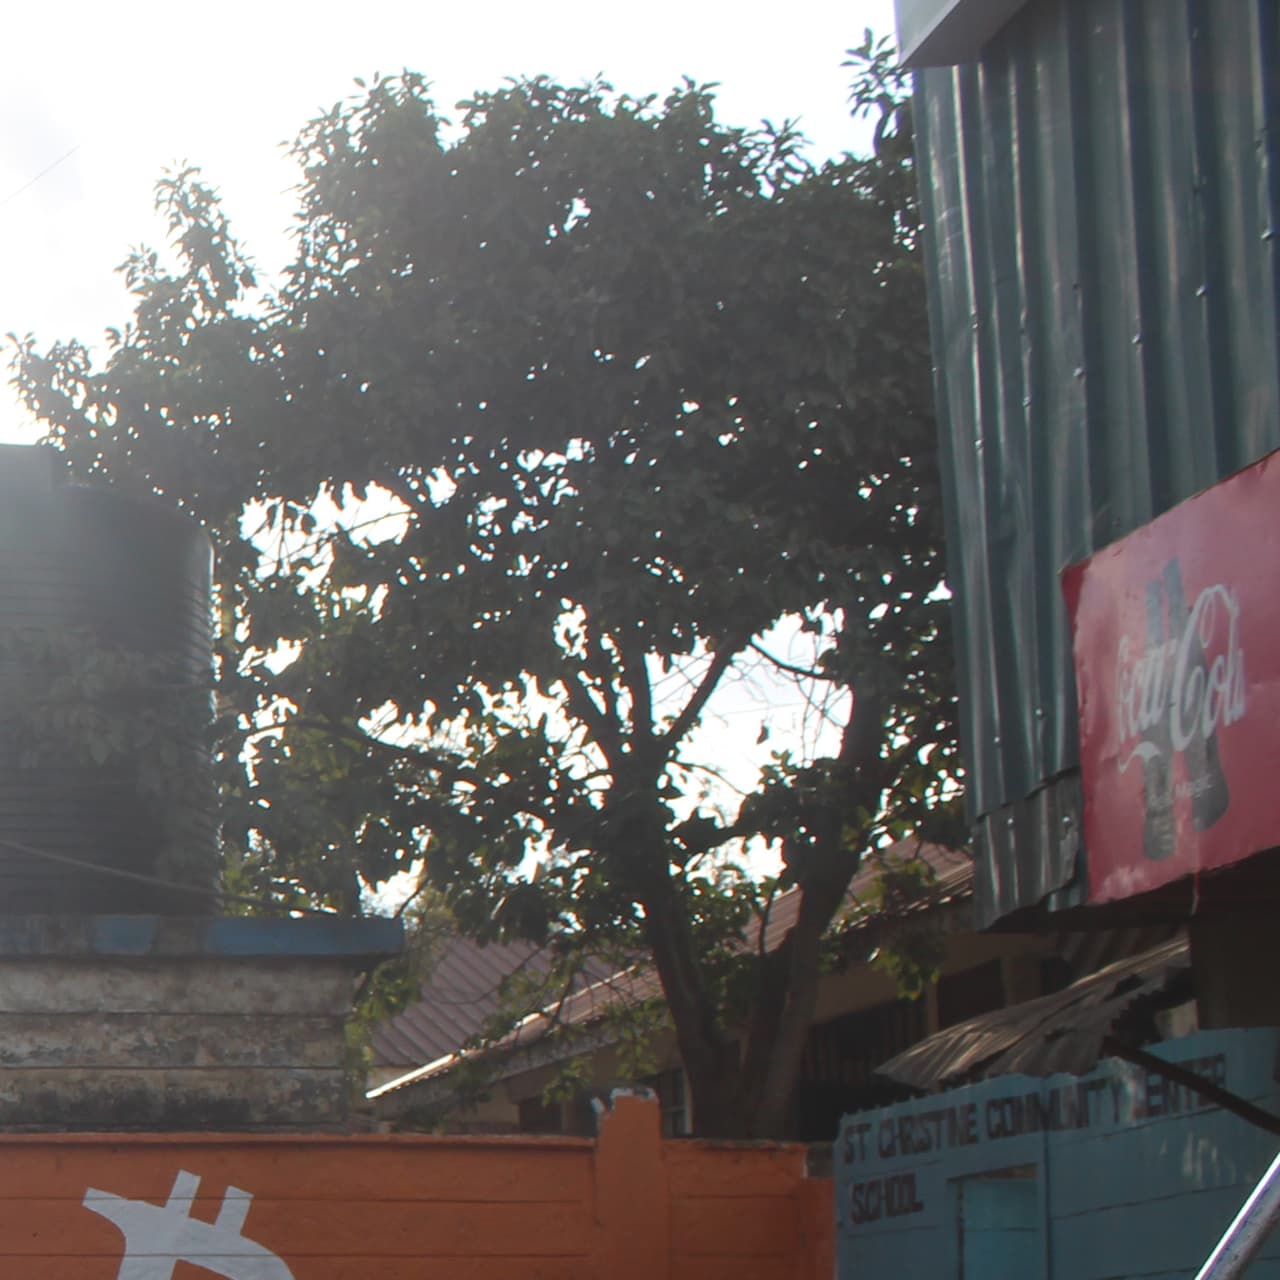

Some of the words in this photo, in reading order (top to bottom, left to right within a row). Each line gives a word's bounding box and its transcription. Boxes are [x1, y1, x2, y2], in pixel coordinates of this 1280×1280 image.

[843, 1123, 872, 1164] ST
[985, 1076, 1124, 1140] COMMUNITY
[850, 1172, 925, 1225] SCHOOL
